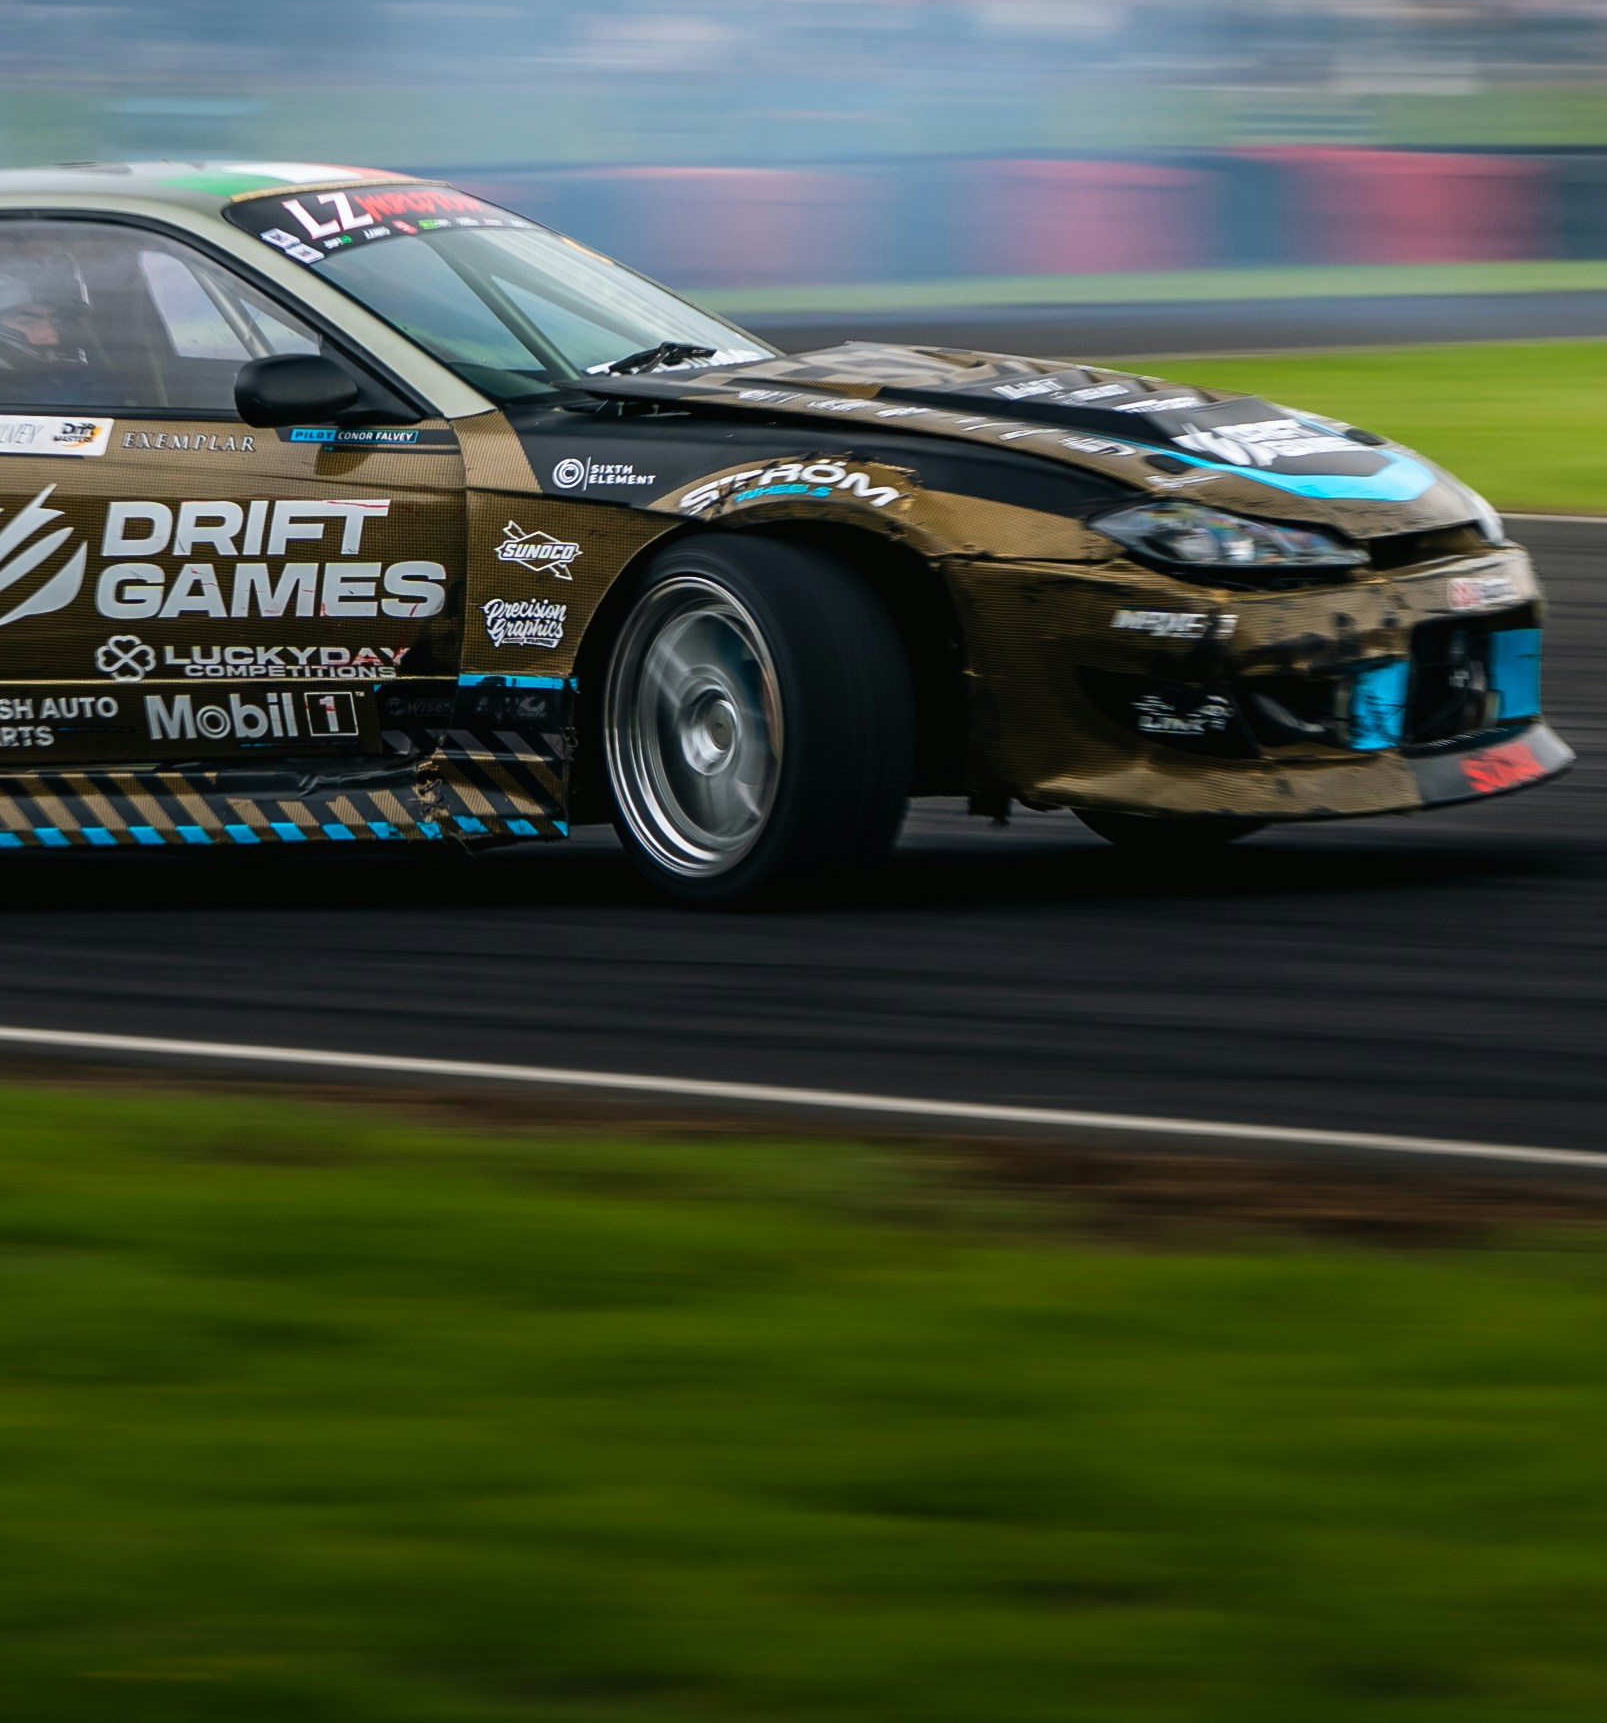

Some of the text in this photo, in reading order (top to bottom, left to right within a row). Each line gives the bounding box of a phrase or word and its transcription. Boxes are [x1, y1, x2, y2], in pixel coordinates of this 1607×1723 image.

[281, 181, 374, 240] LZ
[122, 432, 256, 453] EXEMPLAR
[295, 431, 413, 441] PILOT CONOR FALVEY
[589, 475, 656, 485] ELEMENT
[590, 465, 633, 474] SIXTH
[100, 499, 392, 557] DRIFT
[503, 543, 575, 559] SUNOCO
[96, 561, 448, 620] GAMES
[480, 598, 568, 626] Precision
[487, 618, 564, 647] Graphics
[164, 646, 410, 666] LUCKYDAY
[184, 665, 397, 677] COMPETITIONS
[39, 696, 119, 720] AUTO
[144, 693, 298, 740] Mobil
[318, 695, 340, 733] 1
